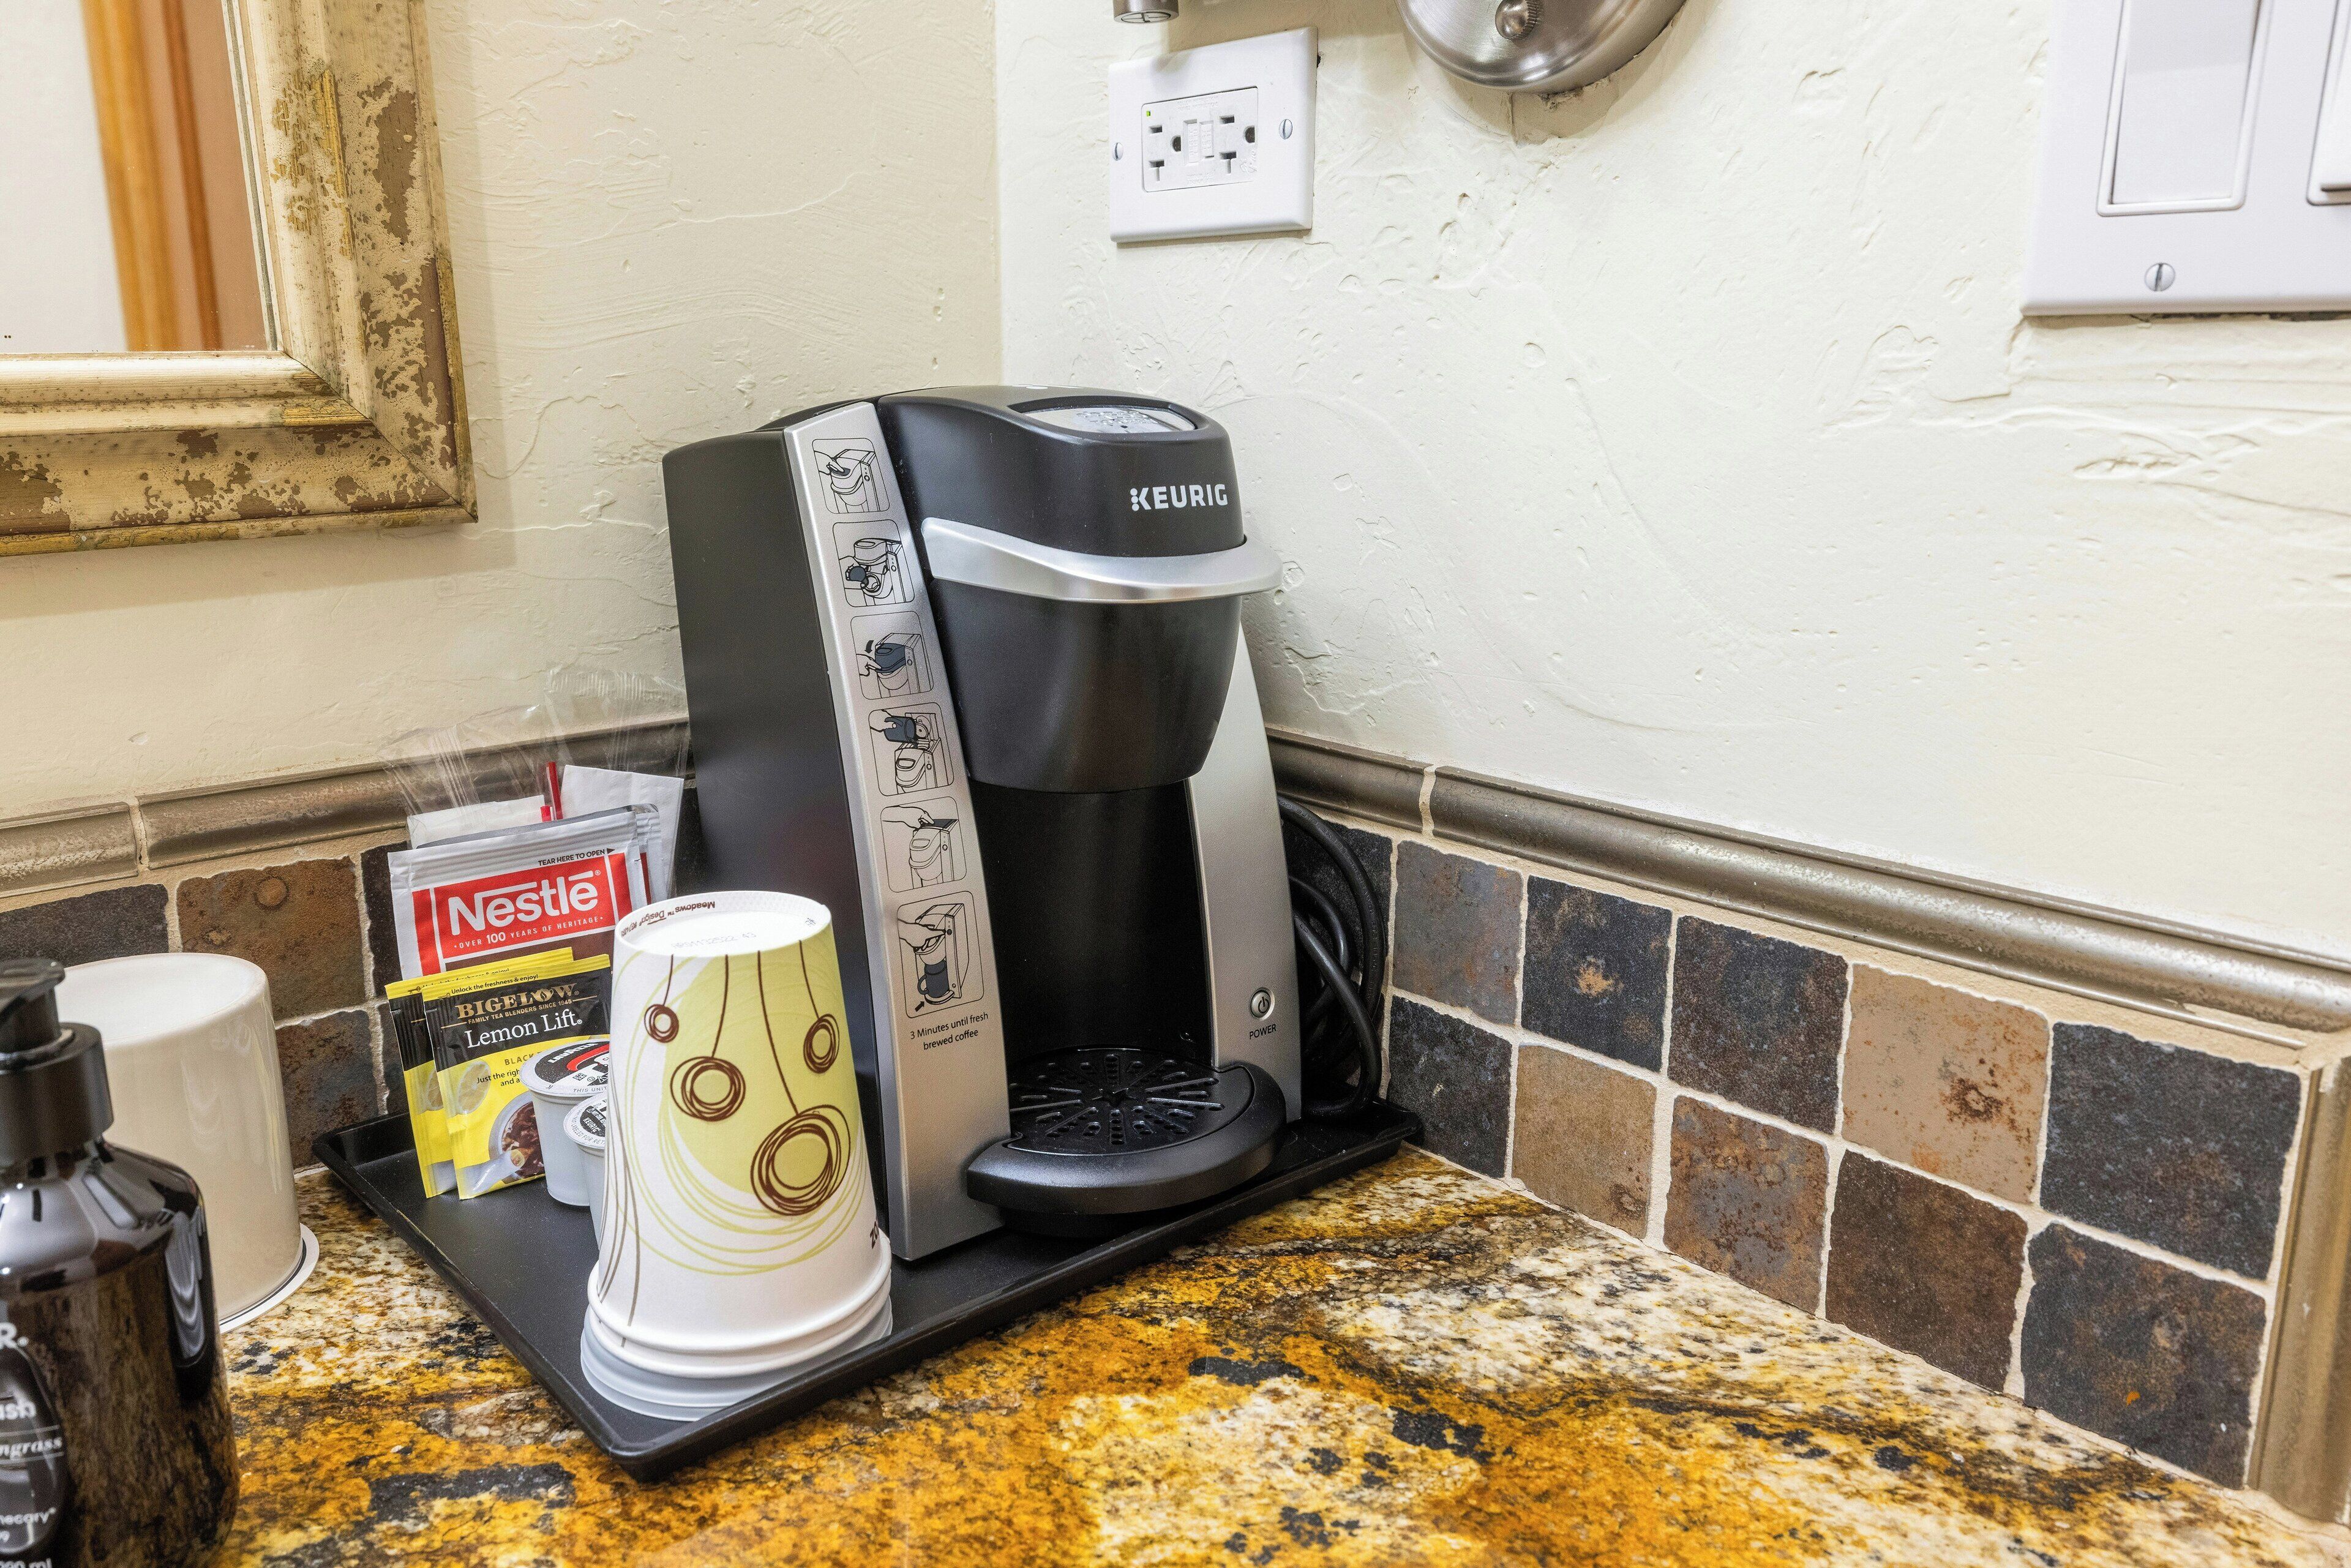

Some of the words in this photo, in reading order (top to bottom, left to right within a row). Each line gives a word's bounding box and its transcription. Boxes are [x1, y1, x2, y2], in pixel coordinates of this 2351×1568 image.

[1130, 484, 1228, 511] KEURIG
[557, 855, 574, 863] HERE
[587, 849, 605, 857] OPEN
[459, 939, 482, 949] OVER
[486, 932, 506, 944] 100
[510, 928, 538, 938] YEARS
[557, 916, 599, 929] HERITAGE
[451, 986, 473, 994] Unlock
[485, 978, 513, 988] freshness
[520, 973, 539, 982] enjoy!
[468, 1016, 489, 1025] FAMILY
[504, 1006, 537, 1018] BLENDERS
[538, 1002, 557, 1011] SINCE
[464, 1021, 539, 1048] Lemon
[910, 1031, 915, 1040] 3
[917, 1023, 949, 1038] Minutes
[951, 1016, 969, 1029] until
[970, 1011, 989, 1024] fresh
[1249, 1024, 1277, 1040] POWER
[923, 1035, 953, 1051] brewed
[955, 1029, 978, 1041] coffee
[476, 1075, 492, 1084] Just
[500, 1078, 514, 1087] and
